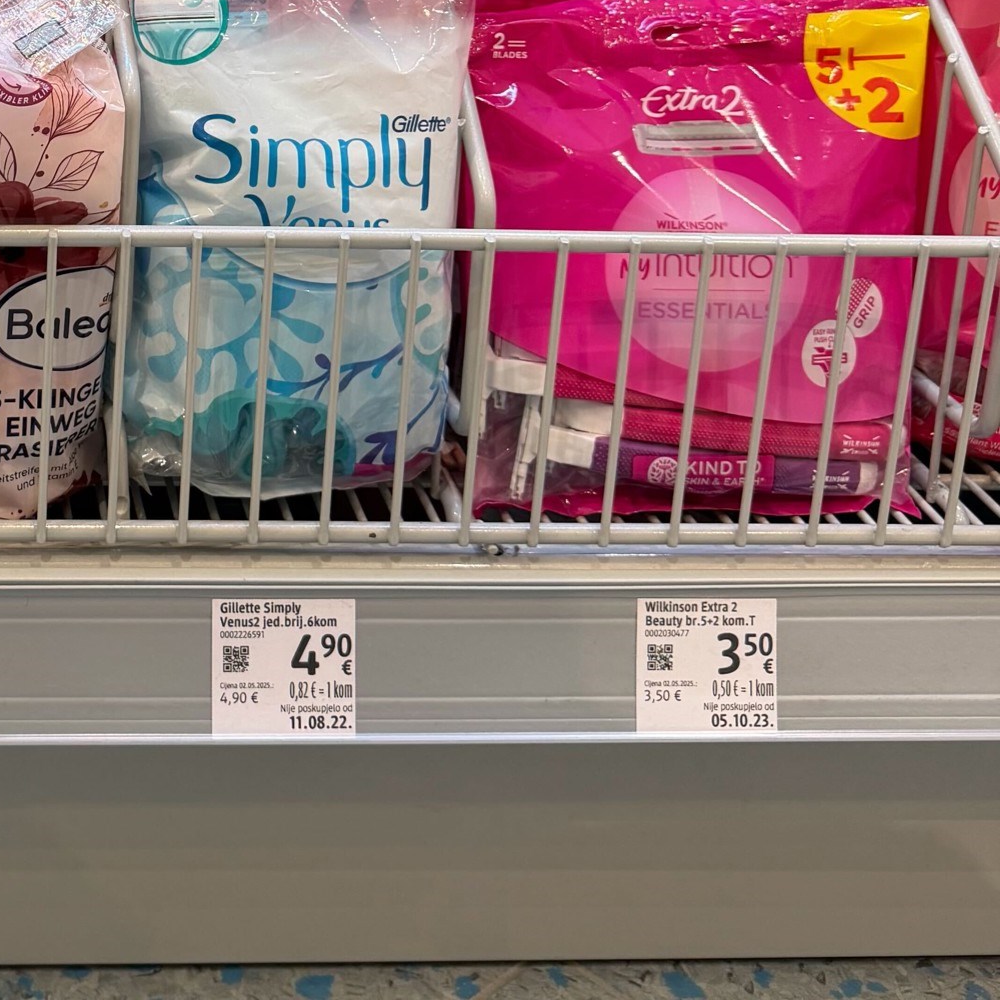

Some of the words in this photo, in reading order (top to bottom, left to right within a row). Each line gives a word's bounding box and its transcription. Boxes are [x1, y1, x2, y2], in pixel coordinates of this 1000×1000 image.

[492, 32, 505, 50] 2
[492, 51, 528, 59] BLADES
[815, 47, 843, 85] 5
[191, 113, 432, 214] Simply
[656, 219, 724, 230] WILKINSON
[853, 295, 876, 329] GRIP
[685, 460, 736, 476] KIND
[16, 477, 36, 492] und
[220, 602, 260, 614] Gillette
[263, 602, 302, 615] Simply
[645, 601, 698, 612] Wilkinson
[701, 601, 729, 613] Extra
[731, 602, 737, 612] 2
[220, 616, 260, 628] Venus2
[262, 616, 337, 629] jed.brij.6kom
[645, 615, 683, 628] Beauty
[685, 615, 719, 626] br.5+2
[722, 615, 756, 626] kom.T
[220, 630, 265, 639] 0002226591
[644, 629, 689, 637] 0002030477
[289, 681, 309, 702] 0,82
[334, 680, 353, 699] kom
[712, 680, 731, 700] 0,50
[756, 679, 774, 697] kom
[220, 691, 247, 706] 4,90
[644, 690, 670, 703] 3,50
[280, 704, 296, 714] Nije
[298, 704, 340, 714] poskupjelo
[343, 704, 353, 713] od
[703, 702, 719, 712] Nije
[720, 702, 763, 712] poskupjelo
[764, 702, 774, 711] od
[289, 715, 352, 729] 11.08.22.
[711, 713, 774, 727] 05.10.23.
